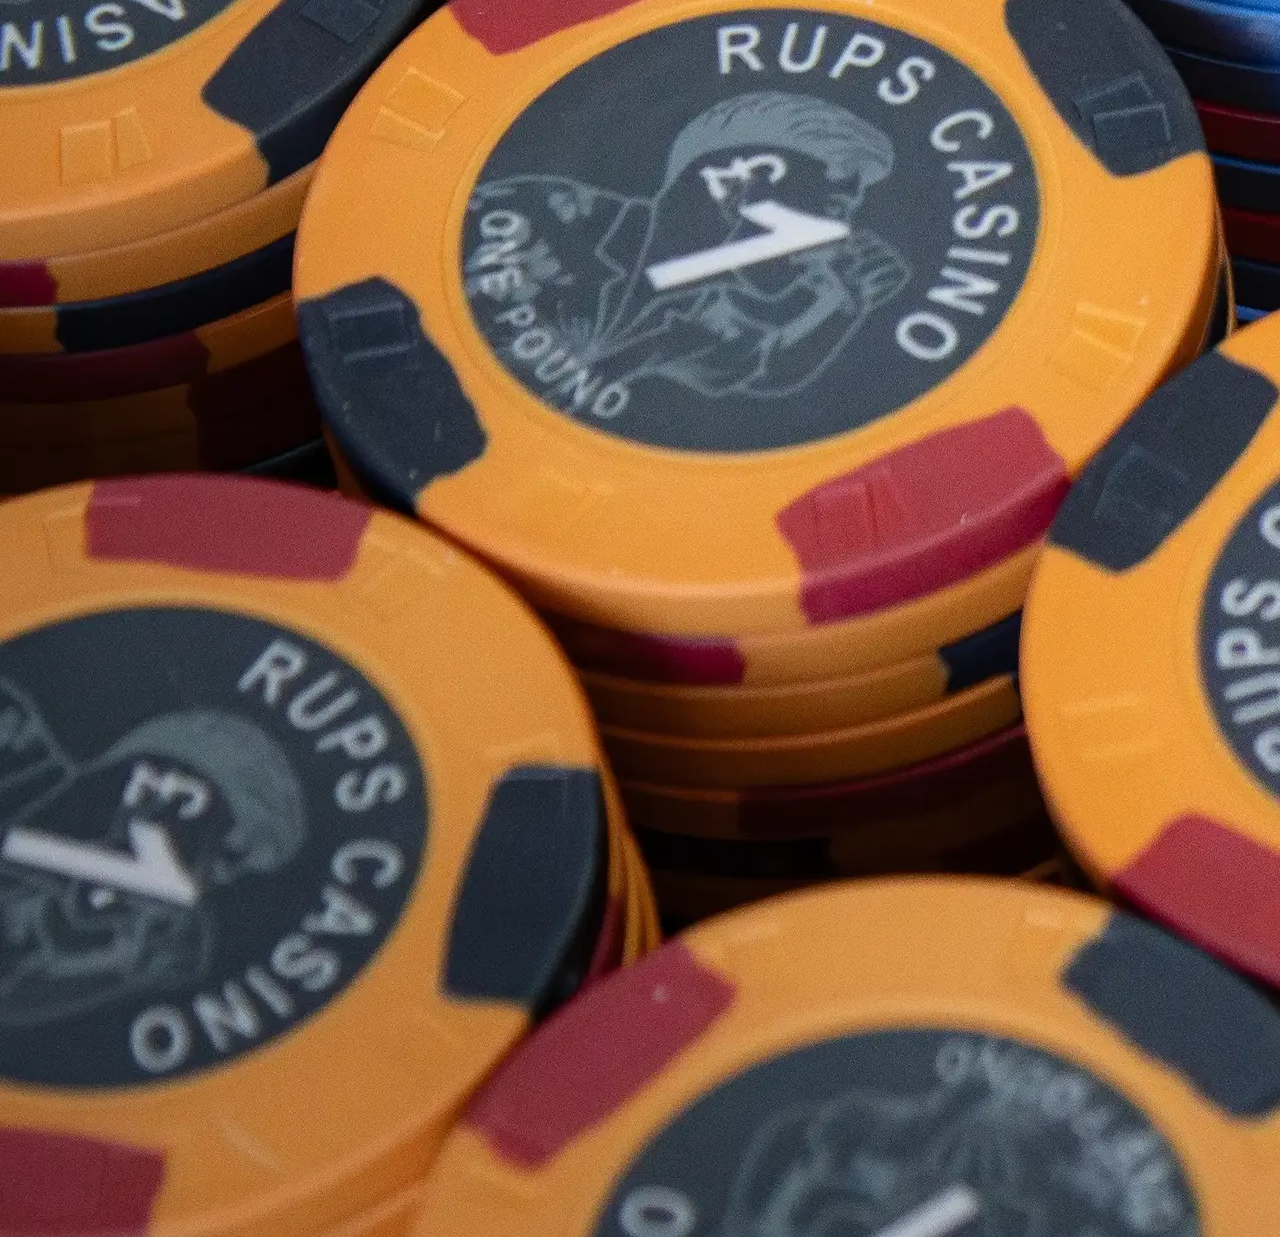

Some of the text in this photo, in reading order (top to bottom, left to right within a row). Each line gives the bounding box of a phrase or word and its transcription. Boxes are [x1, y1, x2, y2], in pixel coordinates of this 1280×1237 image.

[645, 152, 853, 292] £1
[715, 21, 1021, 363] RUPS CASINO
[477, 208, 630, 419] ONE POUND
[0, 761, 213, 909] £1
[128, 636, 407, 1075] RUPS CASINO
